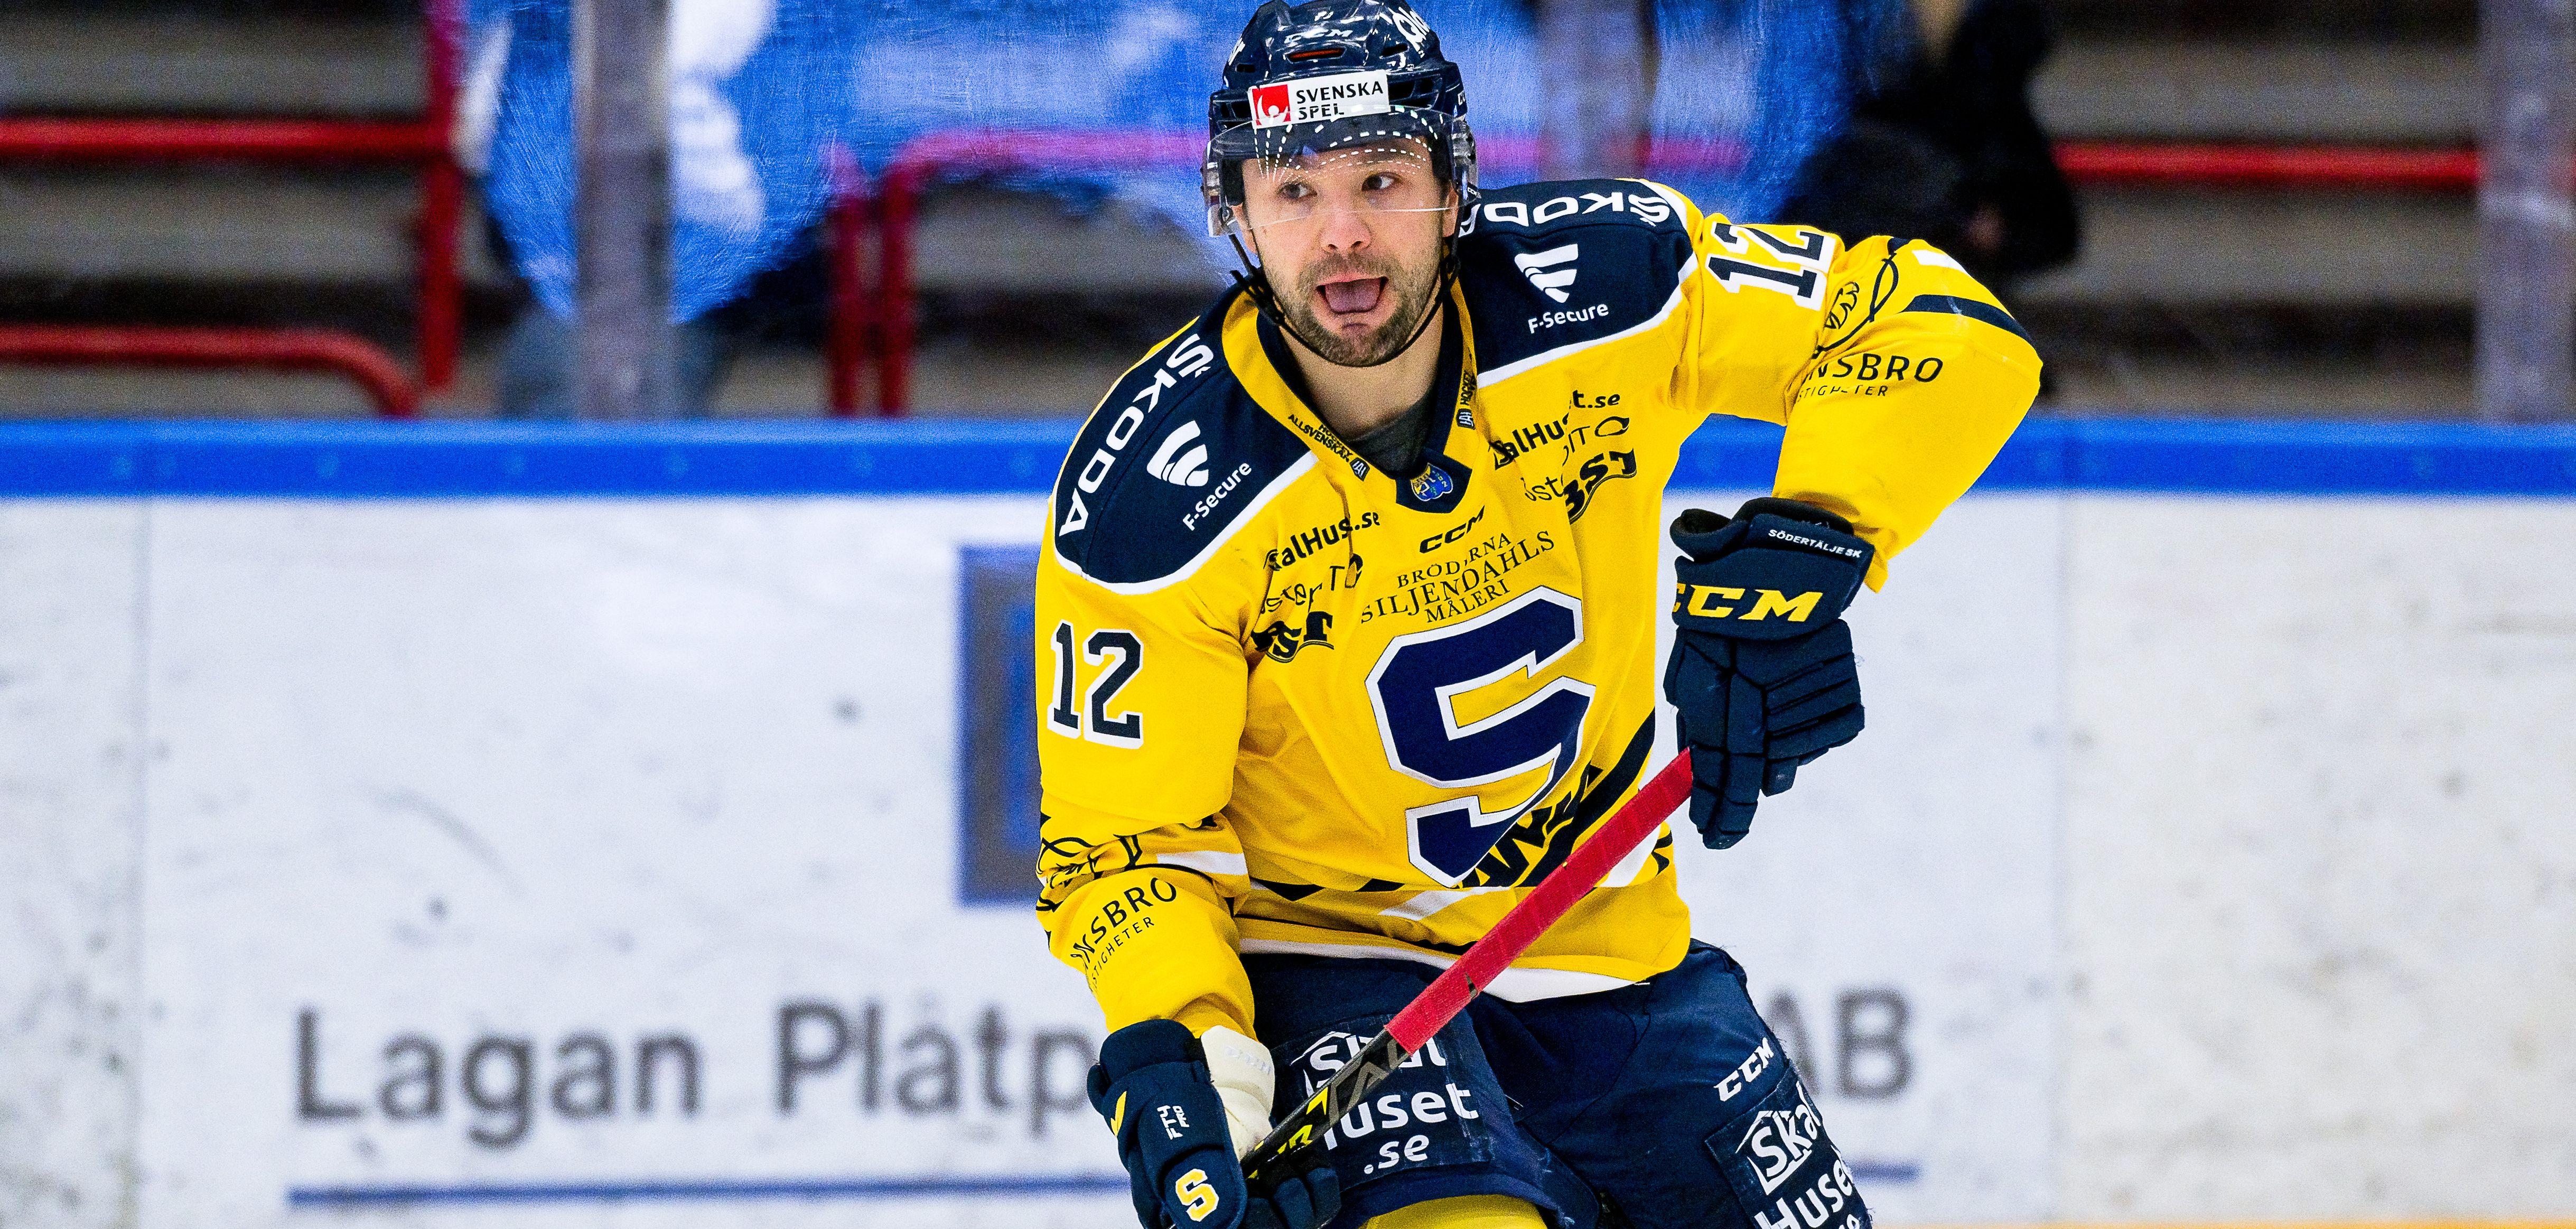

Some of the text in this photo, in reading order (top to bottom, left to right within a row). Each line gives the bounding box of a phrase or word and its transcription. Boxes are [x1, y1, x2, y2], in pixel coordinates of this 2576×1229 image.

[1296, 81, 1383, 104] SVENSKA
[1298, 103, 1345, 120] SPEL
[1705, 222, 1837, 311] 12
[1528, 303, 1609, 334] F-Secure
[1182, 462, 1252, 530] F-Secure
[1420, 505, 1485, 554] CCM
[1768, 529, 1861, 558] SÖDERTÄLJE SK
[1361, 530, 1555, 624] SILJENDAHLS
[1397, 533, 1511, 588] BRÖDRNA
[1425, 579, 1510, 623] MÅLERI
[1047, 619, 1144, 750] 12
[1365, 585, 1596, 888] S
[295, 1004, 704, 1149] Lagan
[1713, 1037, 1774, 1102] CCM
[1364, 1134, 1430, 1174] .se
[1175, 1168, 1219, 1222] S
[1753, 1145, 1853, 1229] Huse
